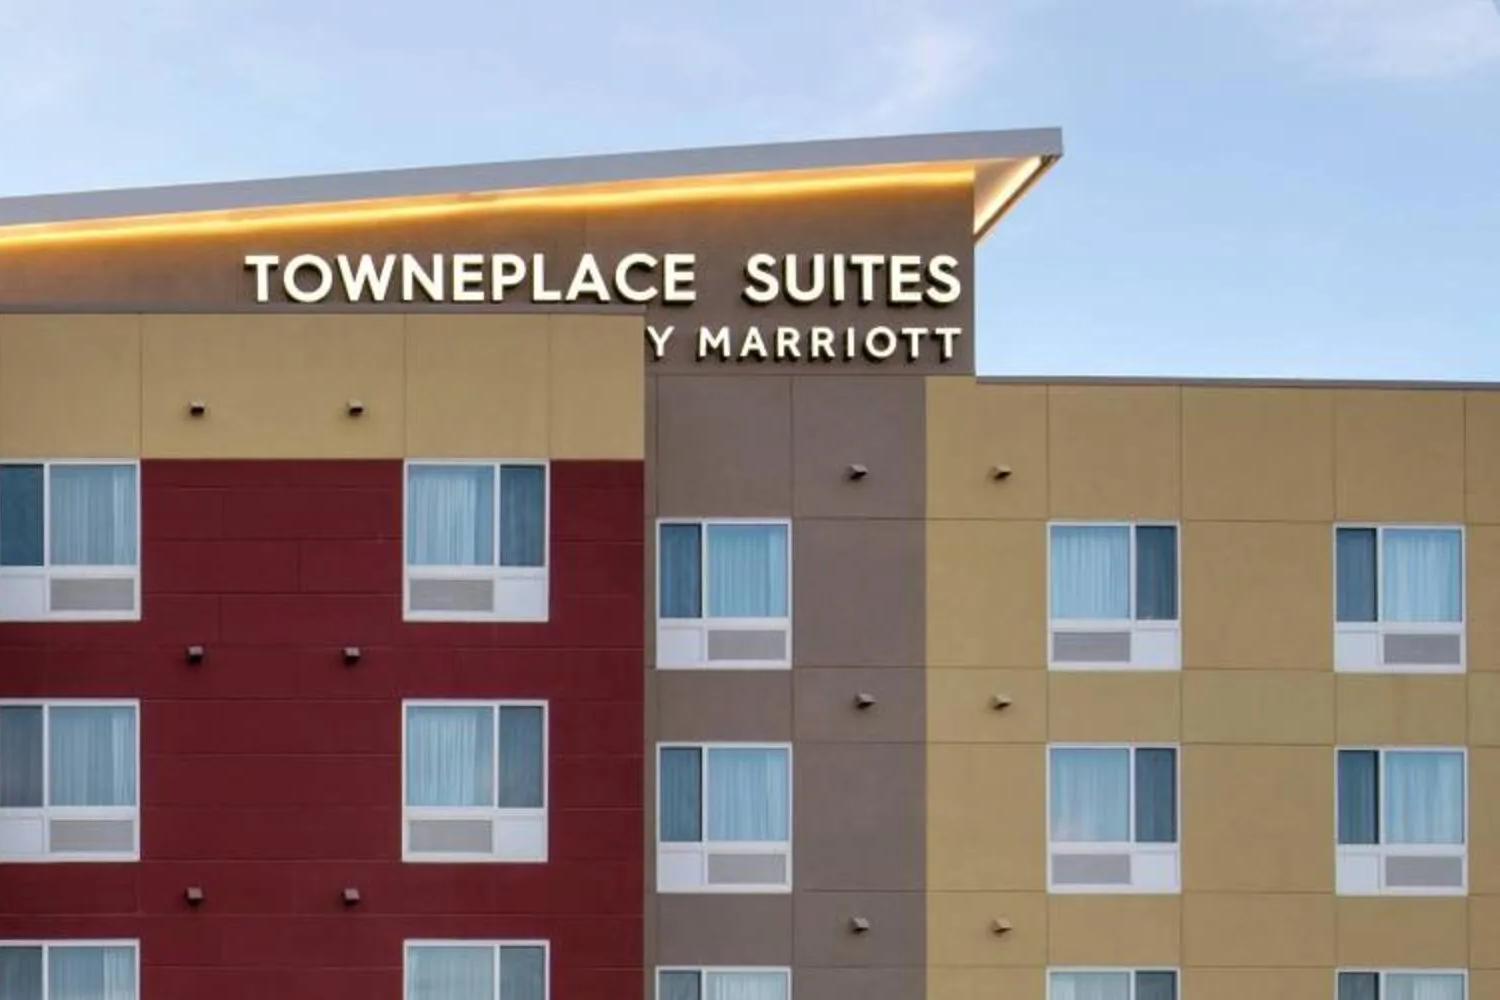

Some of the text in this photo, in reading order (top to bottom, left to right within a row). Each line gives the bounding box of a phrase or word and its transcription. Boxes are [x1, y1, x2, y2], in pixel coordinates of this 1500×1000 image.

[245, 253, 962, 303] TOWNEPLACE SUITES
[646, 326, 962, 358] Y MARRIOTT
